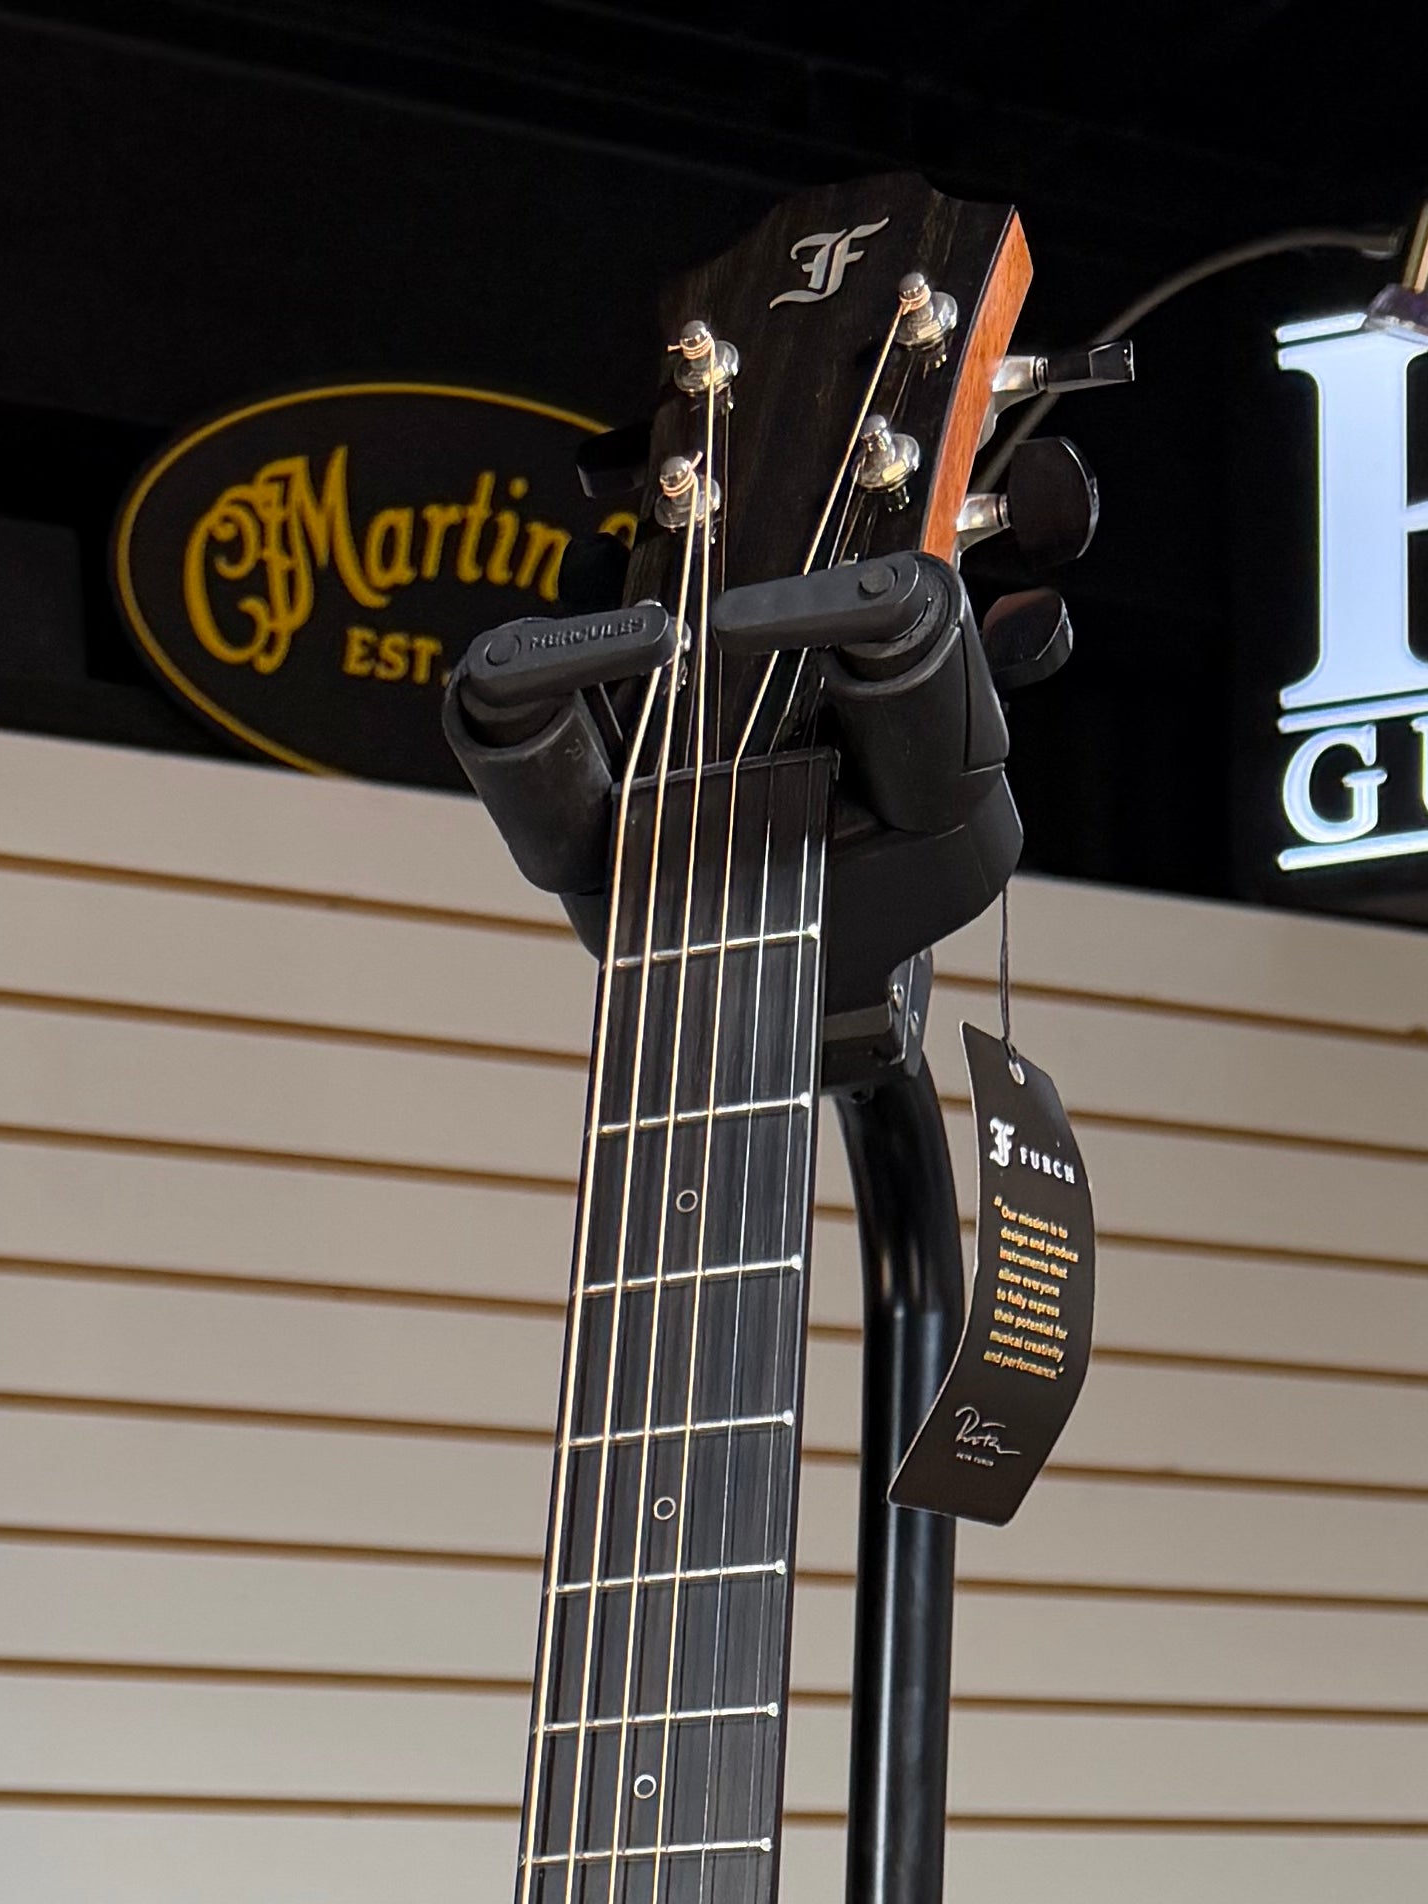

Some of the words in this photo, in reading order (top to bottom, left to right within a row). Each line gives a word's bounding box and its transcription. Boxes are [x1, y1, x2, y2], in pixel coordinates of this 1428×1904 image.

[529, 617, 647, 651] HERCULES
[1019, 1146, 1075, 1184] FURCH
[1018, 1212, 1049, 1233] mission
[1000, 1226, 1029, 1248] design
[1029, 1237, 1046, 1252] and
[1045, 1243, 1079, 1264] produce
[999, 1246, 1049, 1274] instruments
[1049, 1262, 1068, 1280] that
[1022, 1276, 1060, 1298] everyone
[1007, 1289, 1028, 1310] fully
[1027, 1299, 1060, 1319] express
[1014, 1315, 1054, 1337] potential
[989, 1330, 1023, 1349] musical
[1023, 1340, 1065, 1363] creativity
